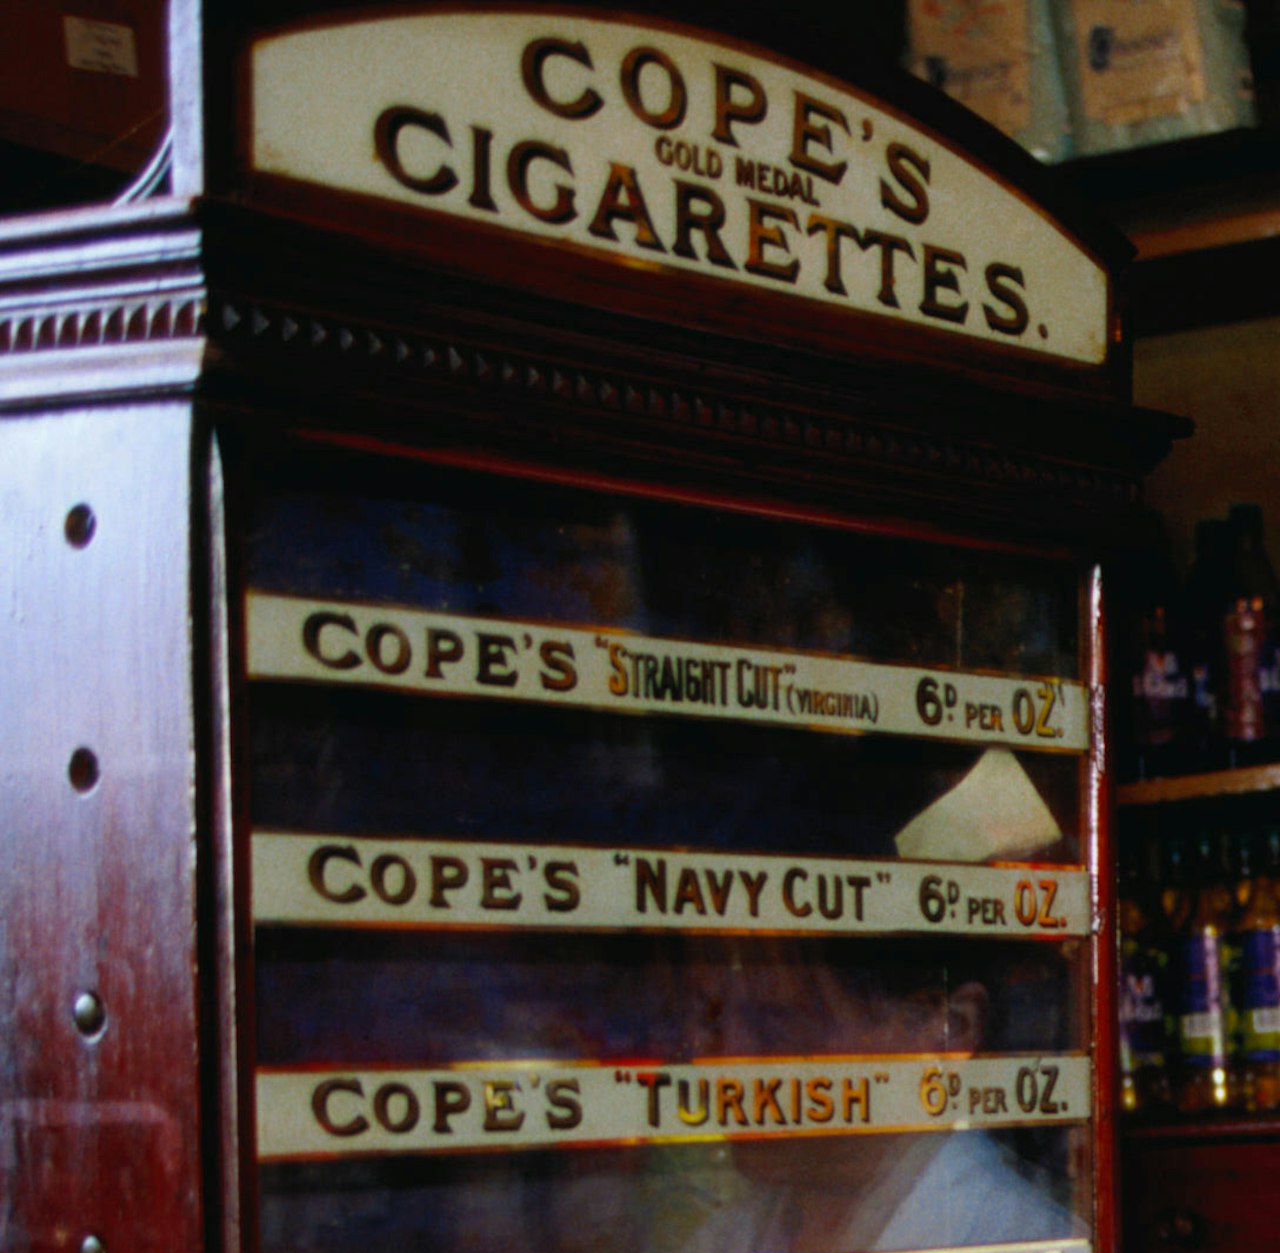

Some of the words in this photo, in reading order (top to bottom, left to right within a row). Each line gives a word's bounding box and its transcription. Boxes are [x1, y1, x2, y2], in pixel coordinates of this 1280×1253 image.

[520, 35, 931, 224] COPE'S
[654, 136, 723, 182] GOLD
[735, 155, 820, 207] MEDAL
[372, 105, 1049, 340] CIGARETTES.
[302, 609, 580, 693] COPE'S
[965, 708, 1004, 732] PER
[307, 843, 581, 913] COPE'S
[967, 897, 1007, 925] PER
[311, 1074, 584, 1137] COPE'S
[968, 1086, 1008, 1114] PER
